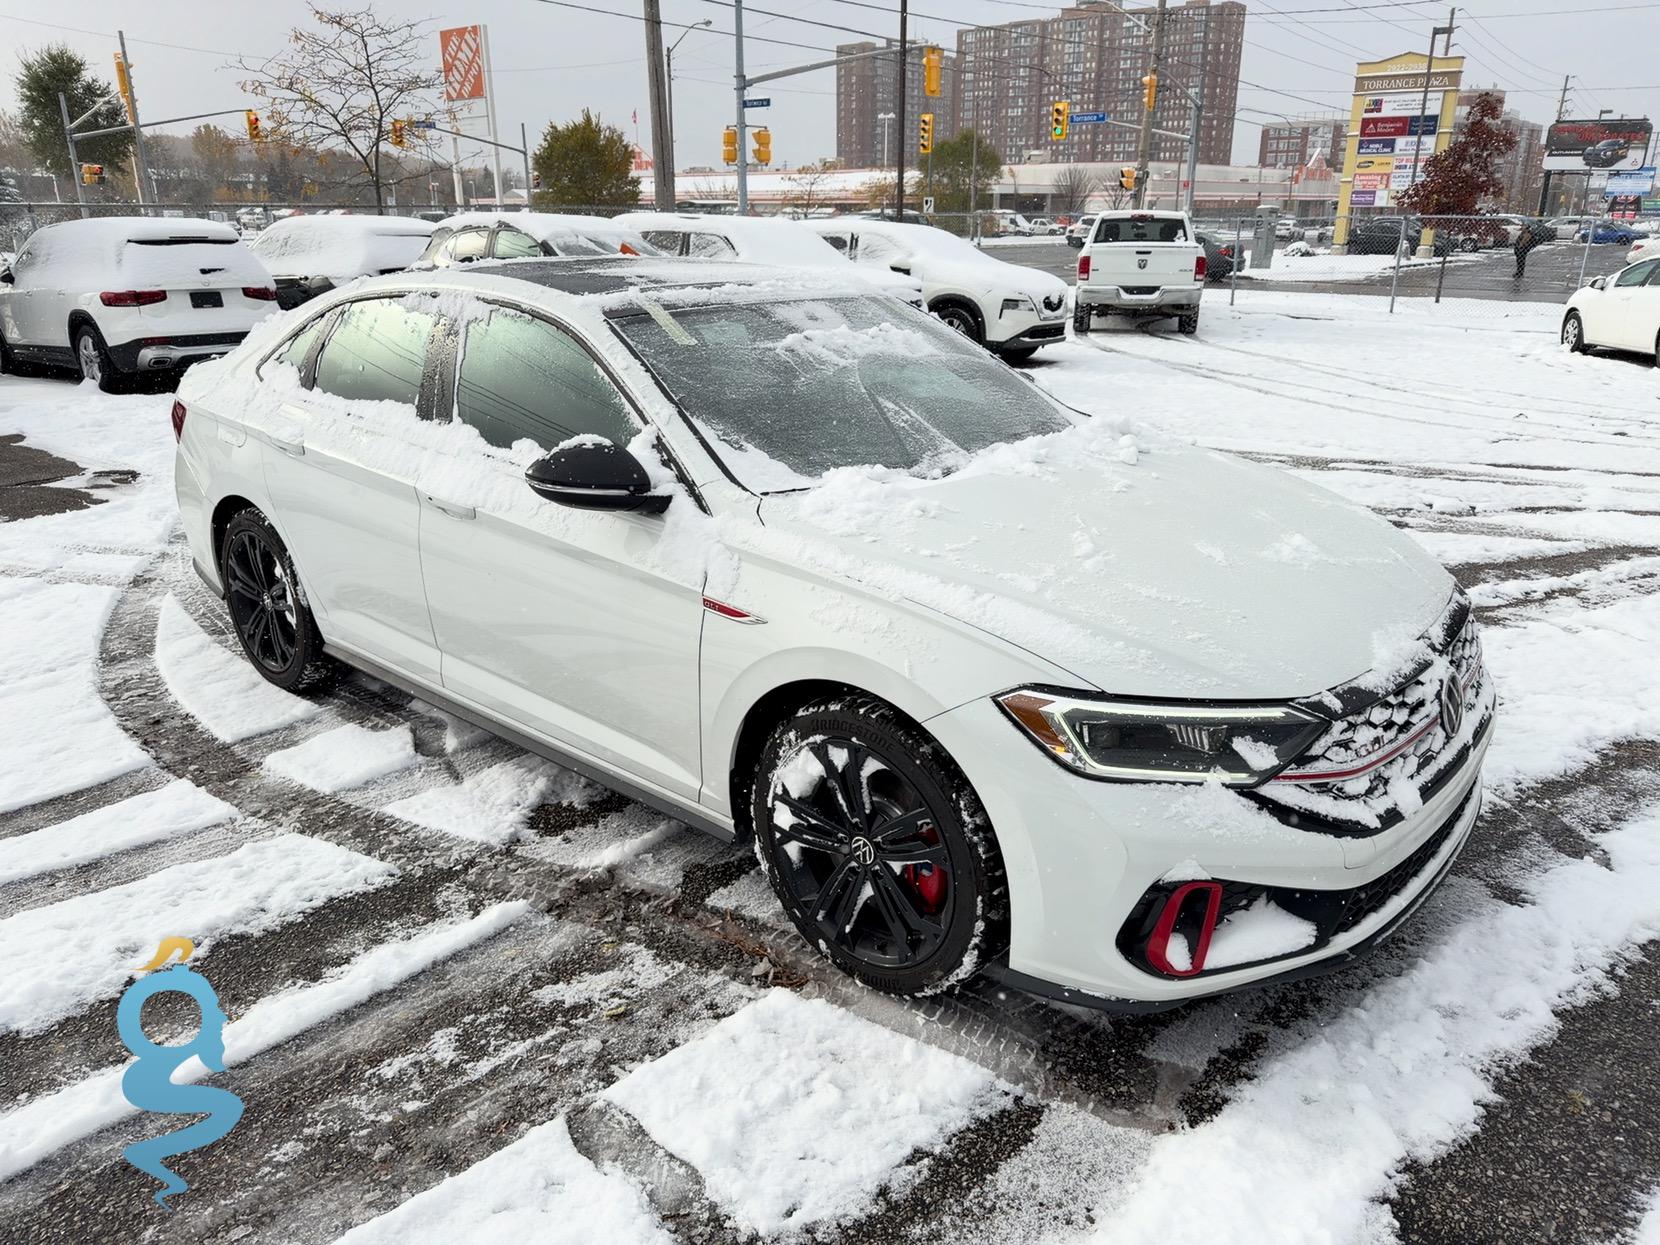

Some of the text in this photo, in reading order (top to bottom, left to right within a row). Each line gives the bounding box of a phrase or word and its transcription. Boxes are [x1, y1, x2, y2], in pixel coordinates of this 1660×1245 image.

[444, 32, 461, 64] THE
[446, 26, 477, 98] HOME
[462, 53, 482, 98] DEPOT
[1363, 78, 1415, 90] TORRANCE
[704, 600, 720, 611] GLI
[811, 718, 896, 751] BRIDGESTONE
